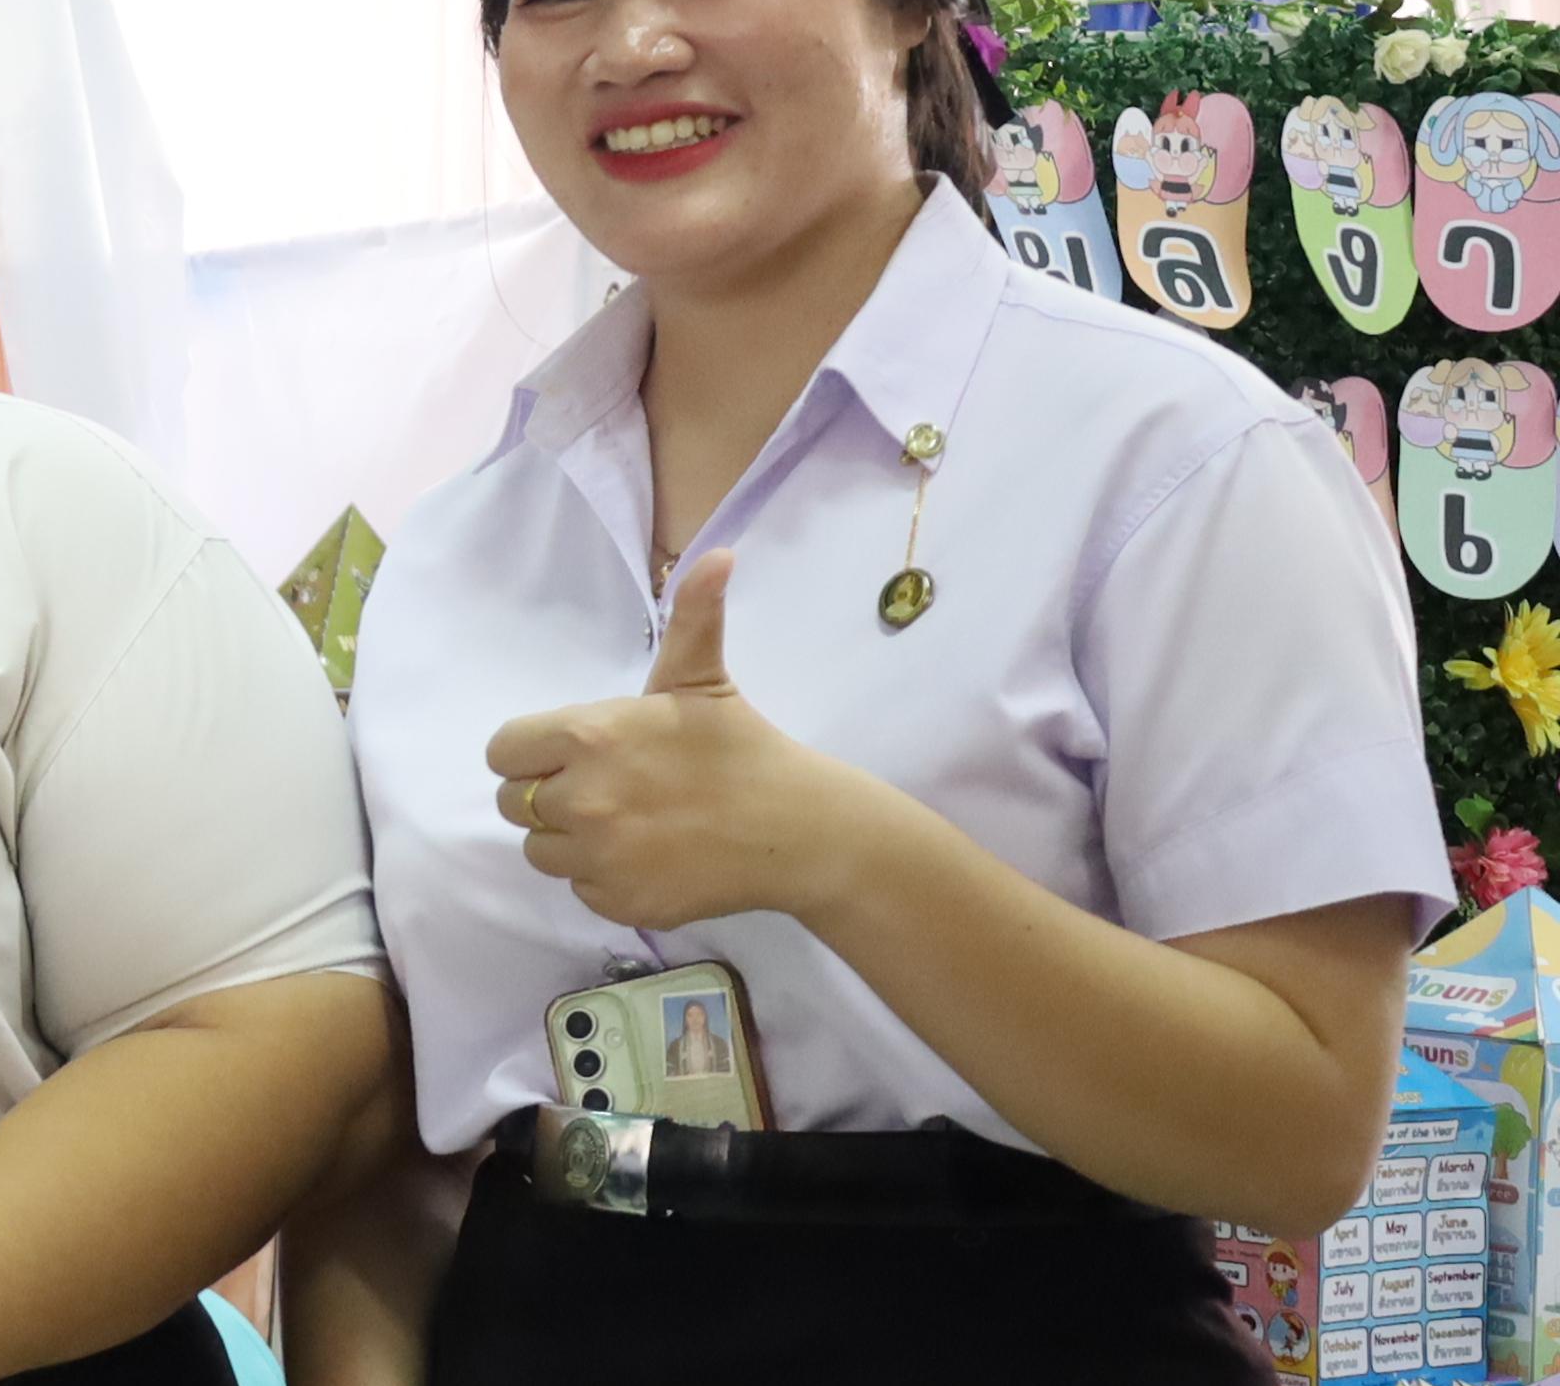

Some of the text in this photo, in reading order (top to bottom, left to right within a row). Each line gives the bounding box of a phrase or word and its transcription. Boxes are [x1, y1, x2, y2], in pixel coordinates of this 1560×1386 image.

[1408, 972, 1508, 1007] Nouns
[1404, 1037, 1469, 1067] ouns
[1385, 1220, 1407, 1235] May
[1438, 1215, 1468, 1229] June
[1427, 1269, 1482, 1285] September
[1333, 1280, 1355, 1297] July
[1374, 1330, 1420, 1346] November
[1428, 1324, 1481, 1341] December
[1323, 1339, 1362, 1354] October
